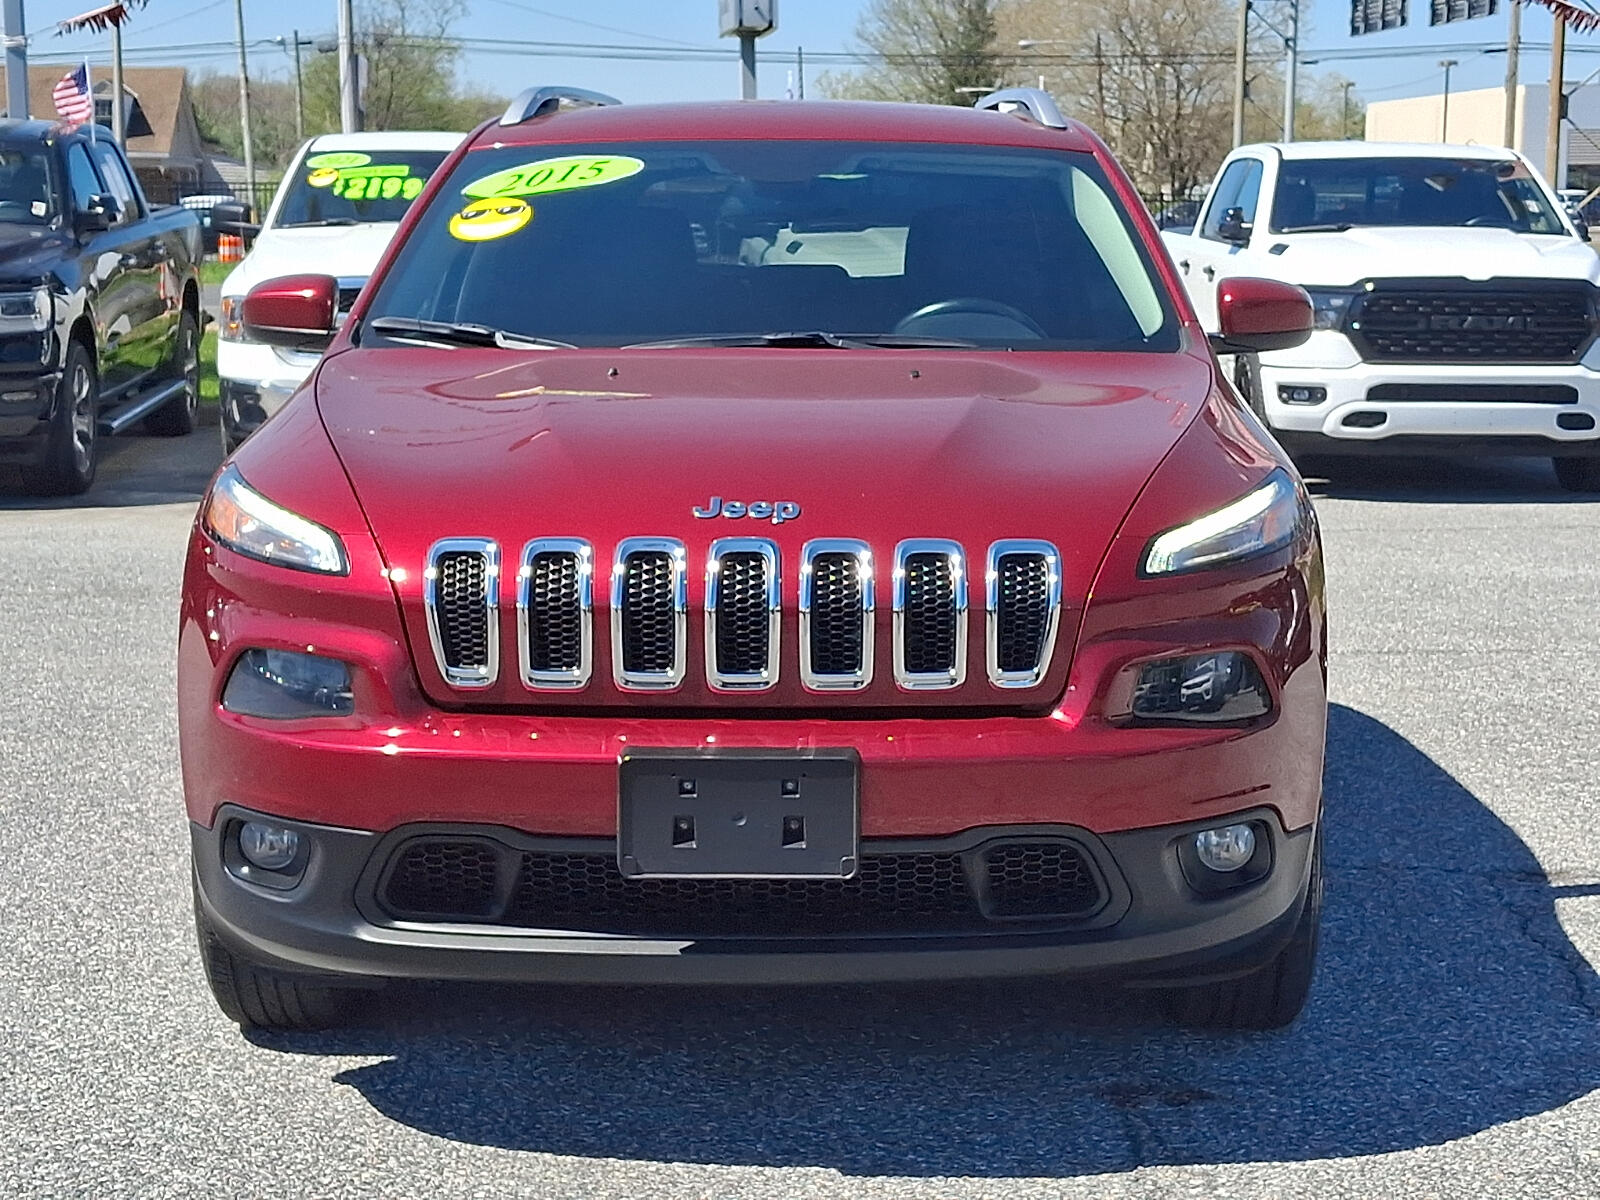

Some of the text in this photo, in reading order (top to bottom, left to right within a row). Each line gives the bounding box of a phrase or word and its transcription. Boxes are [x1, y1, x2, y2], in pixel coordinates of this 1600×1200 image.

[494, 160, 611, 195] 2015
[1429, 314, 1527, 330] RAM
[692, 496, 802, 525] Jeep
